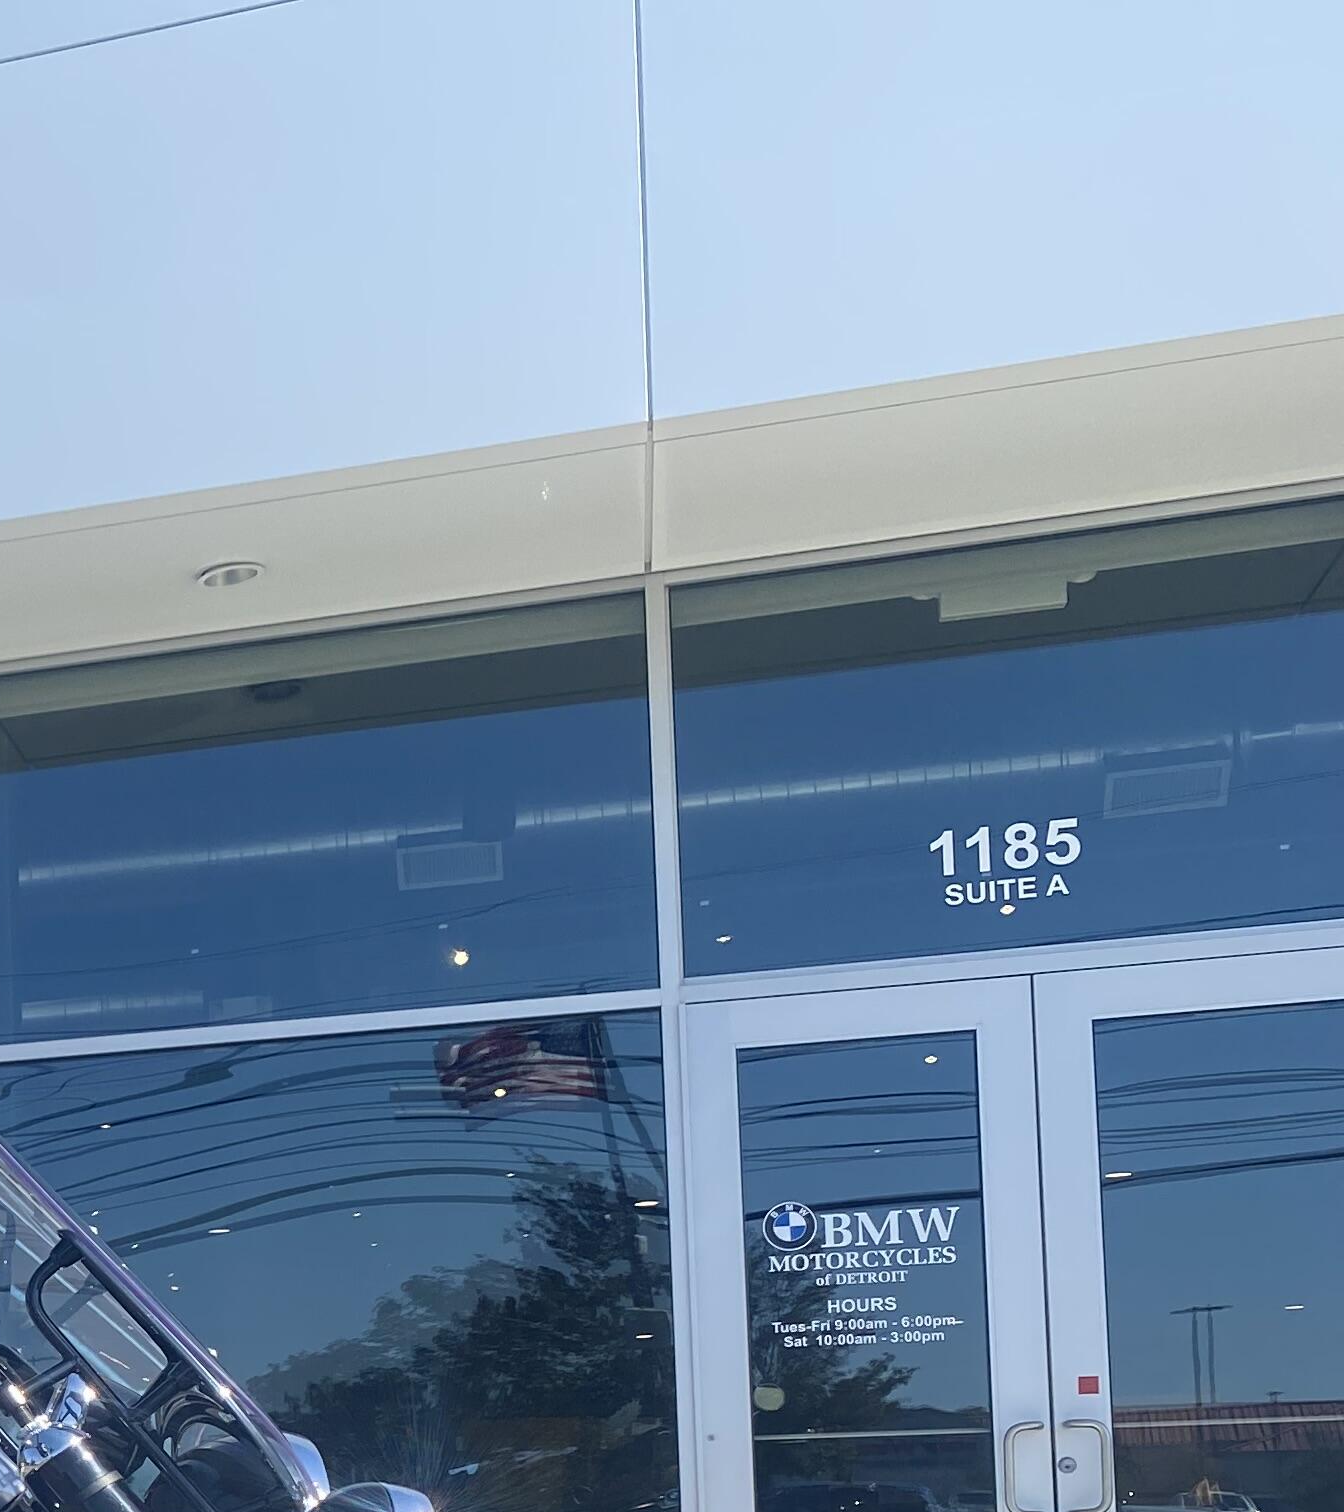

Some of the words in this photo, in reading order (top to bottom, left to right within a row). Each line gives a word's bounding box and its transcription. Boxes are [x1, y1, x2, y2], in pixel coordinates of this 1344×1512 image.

[928, 817, 1081, 877] 1185
[944, 876, 1038, 906] SUITE
[1045, 873, 1070, 897] A
[820, 1206, 961, 1249] BMW
[768, 1246, 957, 1273] MOTORCYCLES
[816, 1273, 833, 1287] of
[835, 1270, 909, 1286] DETROIT
[827, 1296, 898, 1314] HOURS
[771, 1319, 831, 1334] Tues-Fri
[834, 1317, 888, 1331] 9:00am
[900, 1315, 957, 1332] 6:00pm
[783, 1336, 808, 1348] Sat
[815, 1332, 877, 1347] 10:00am
[890, 1330, 945, 1345] 3:00pm
